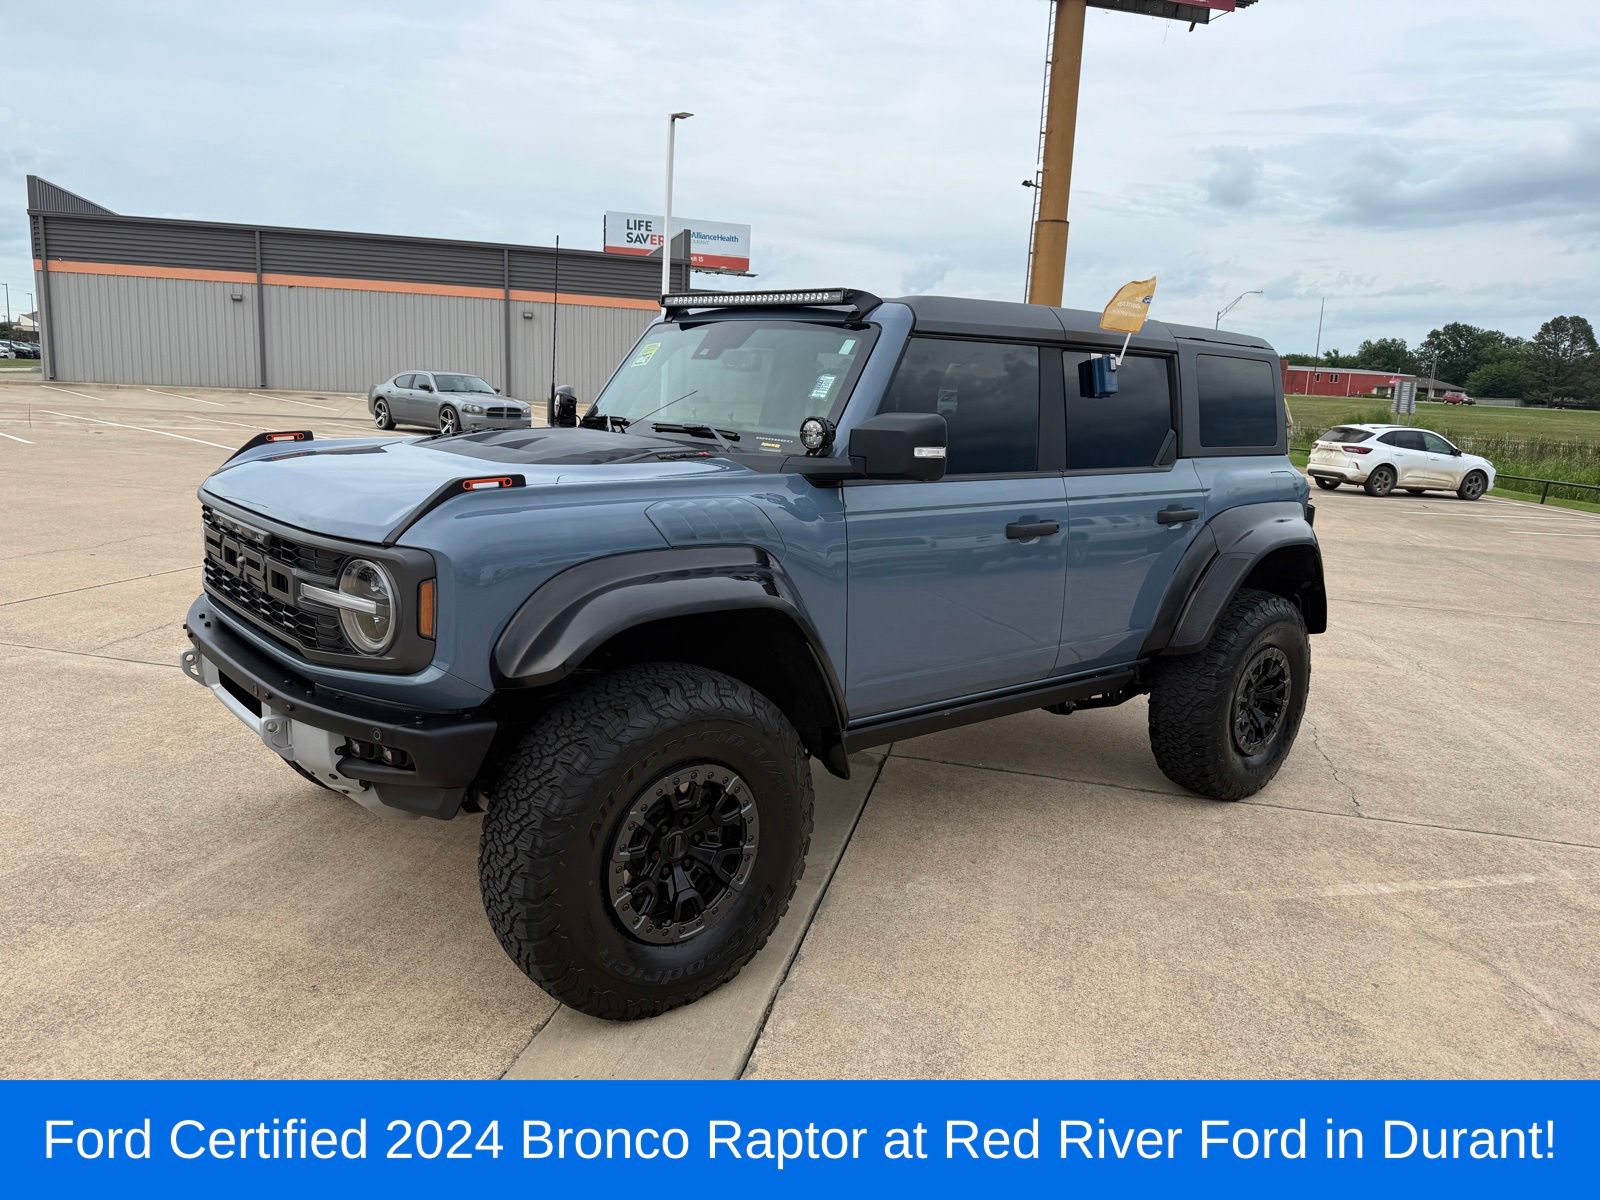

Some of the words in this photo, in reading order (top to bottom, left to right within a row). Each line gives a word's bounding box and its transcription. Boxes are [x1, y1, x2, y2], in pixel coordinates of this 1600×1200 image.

[626, 219, 653, 232] LIFE
[691, 231, 739, 243] AllianceHealth
[204, 526, 297, 604] FORD
